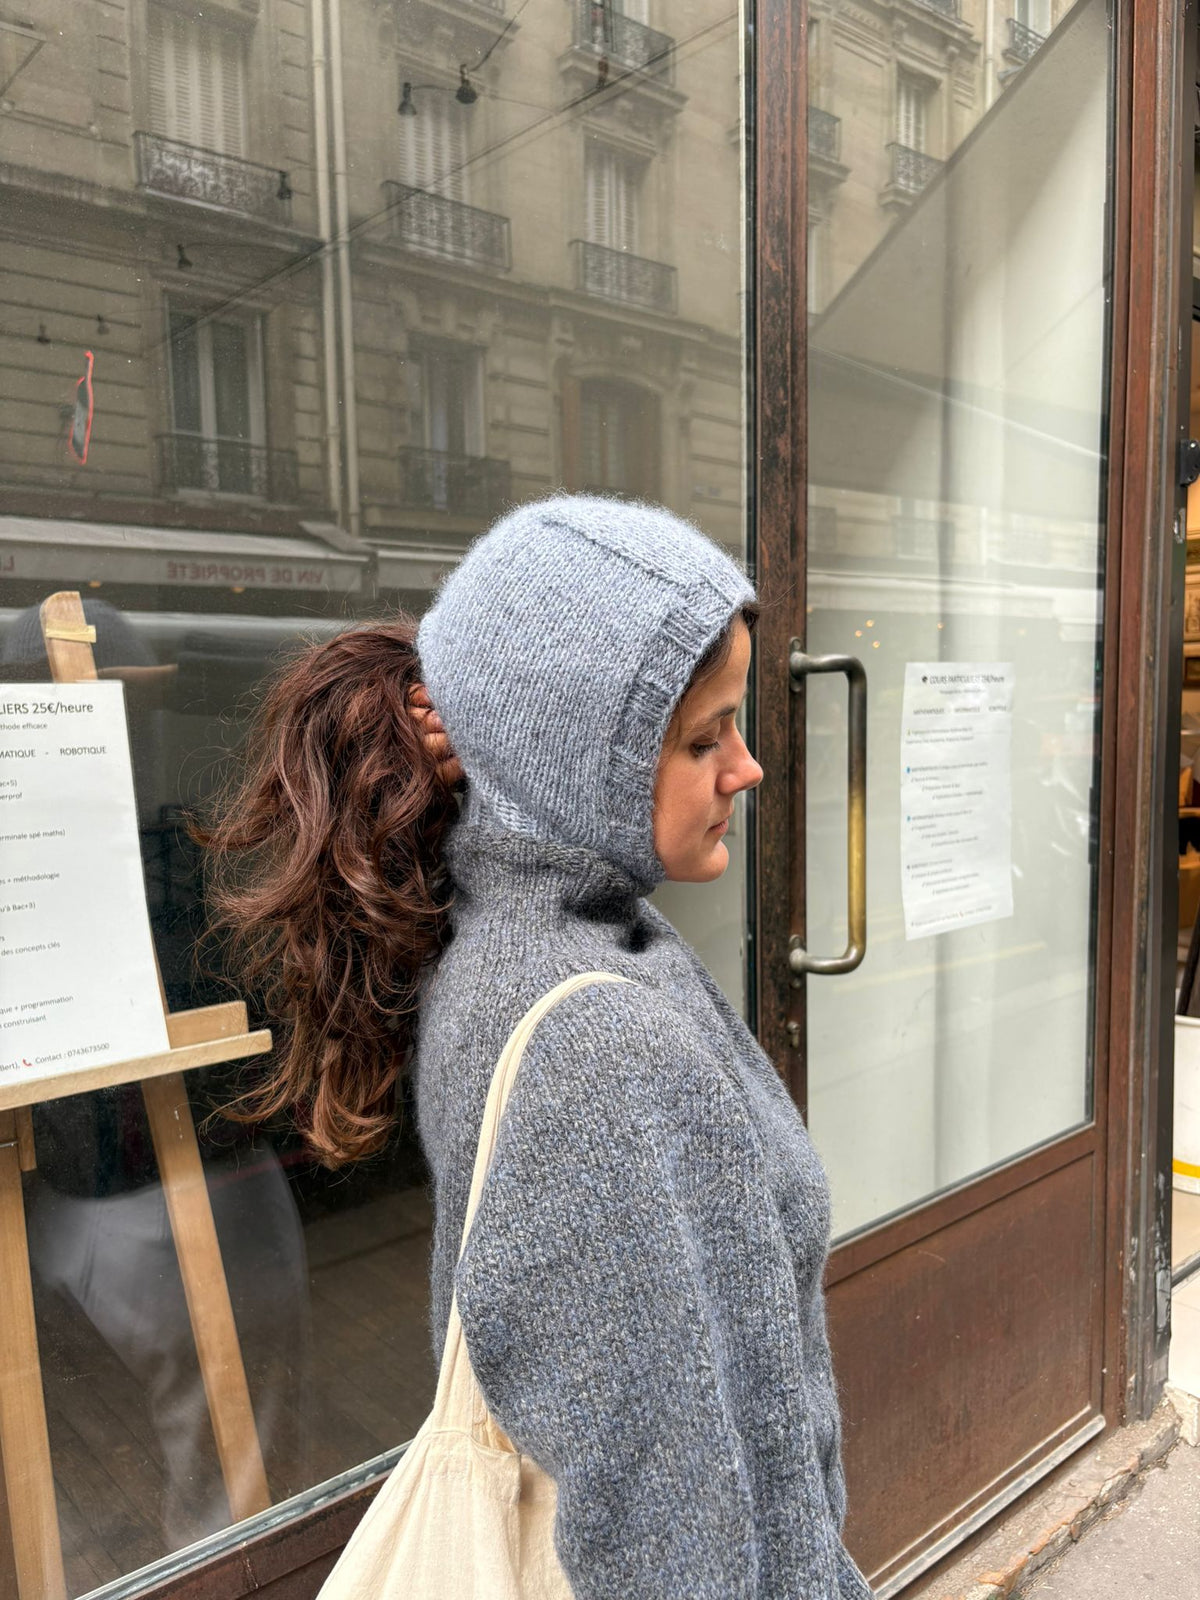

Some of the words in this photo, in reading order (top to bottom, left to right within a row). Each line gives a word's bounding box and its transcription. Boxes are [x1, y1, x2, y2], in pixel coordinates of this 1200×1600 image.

[32, 702, 94, 715] 25€/heure
[22, 722, 47, 730] efficace
[60, 746, 107, 756] ROBOTIQUE
[13, 872, 60, 884] méthodologie
[15, 943, 47, 955] concepts
[20, 996, 74, 1012] programmation
[3, 1014, 47, 1029] construisant
[35, 1053, 62, 1065] Contact
